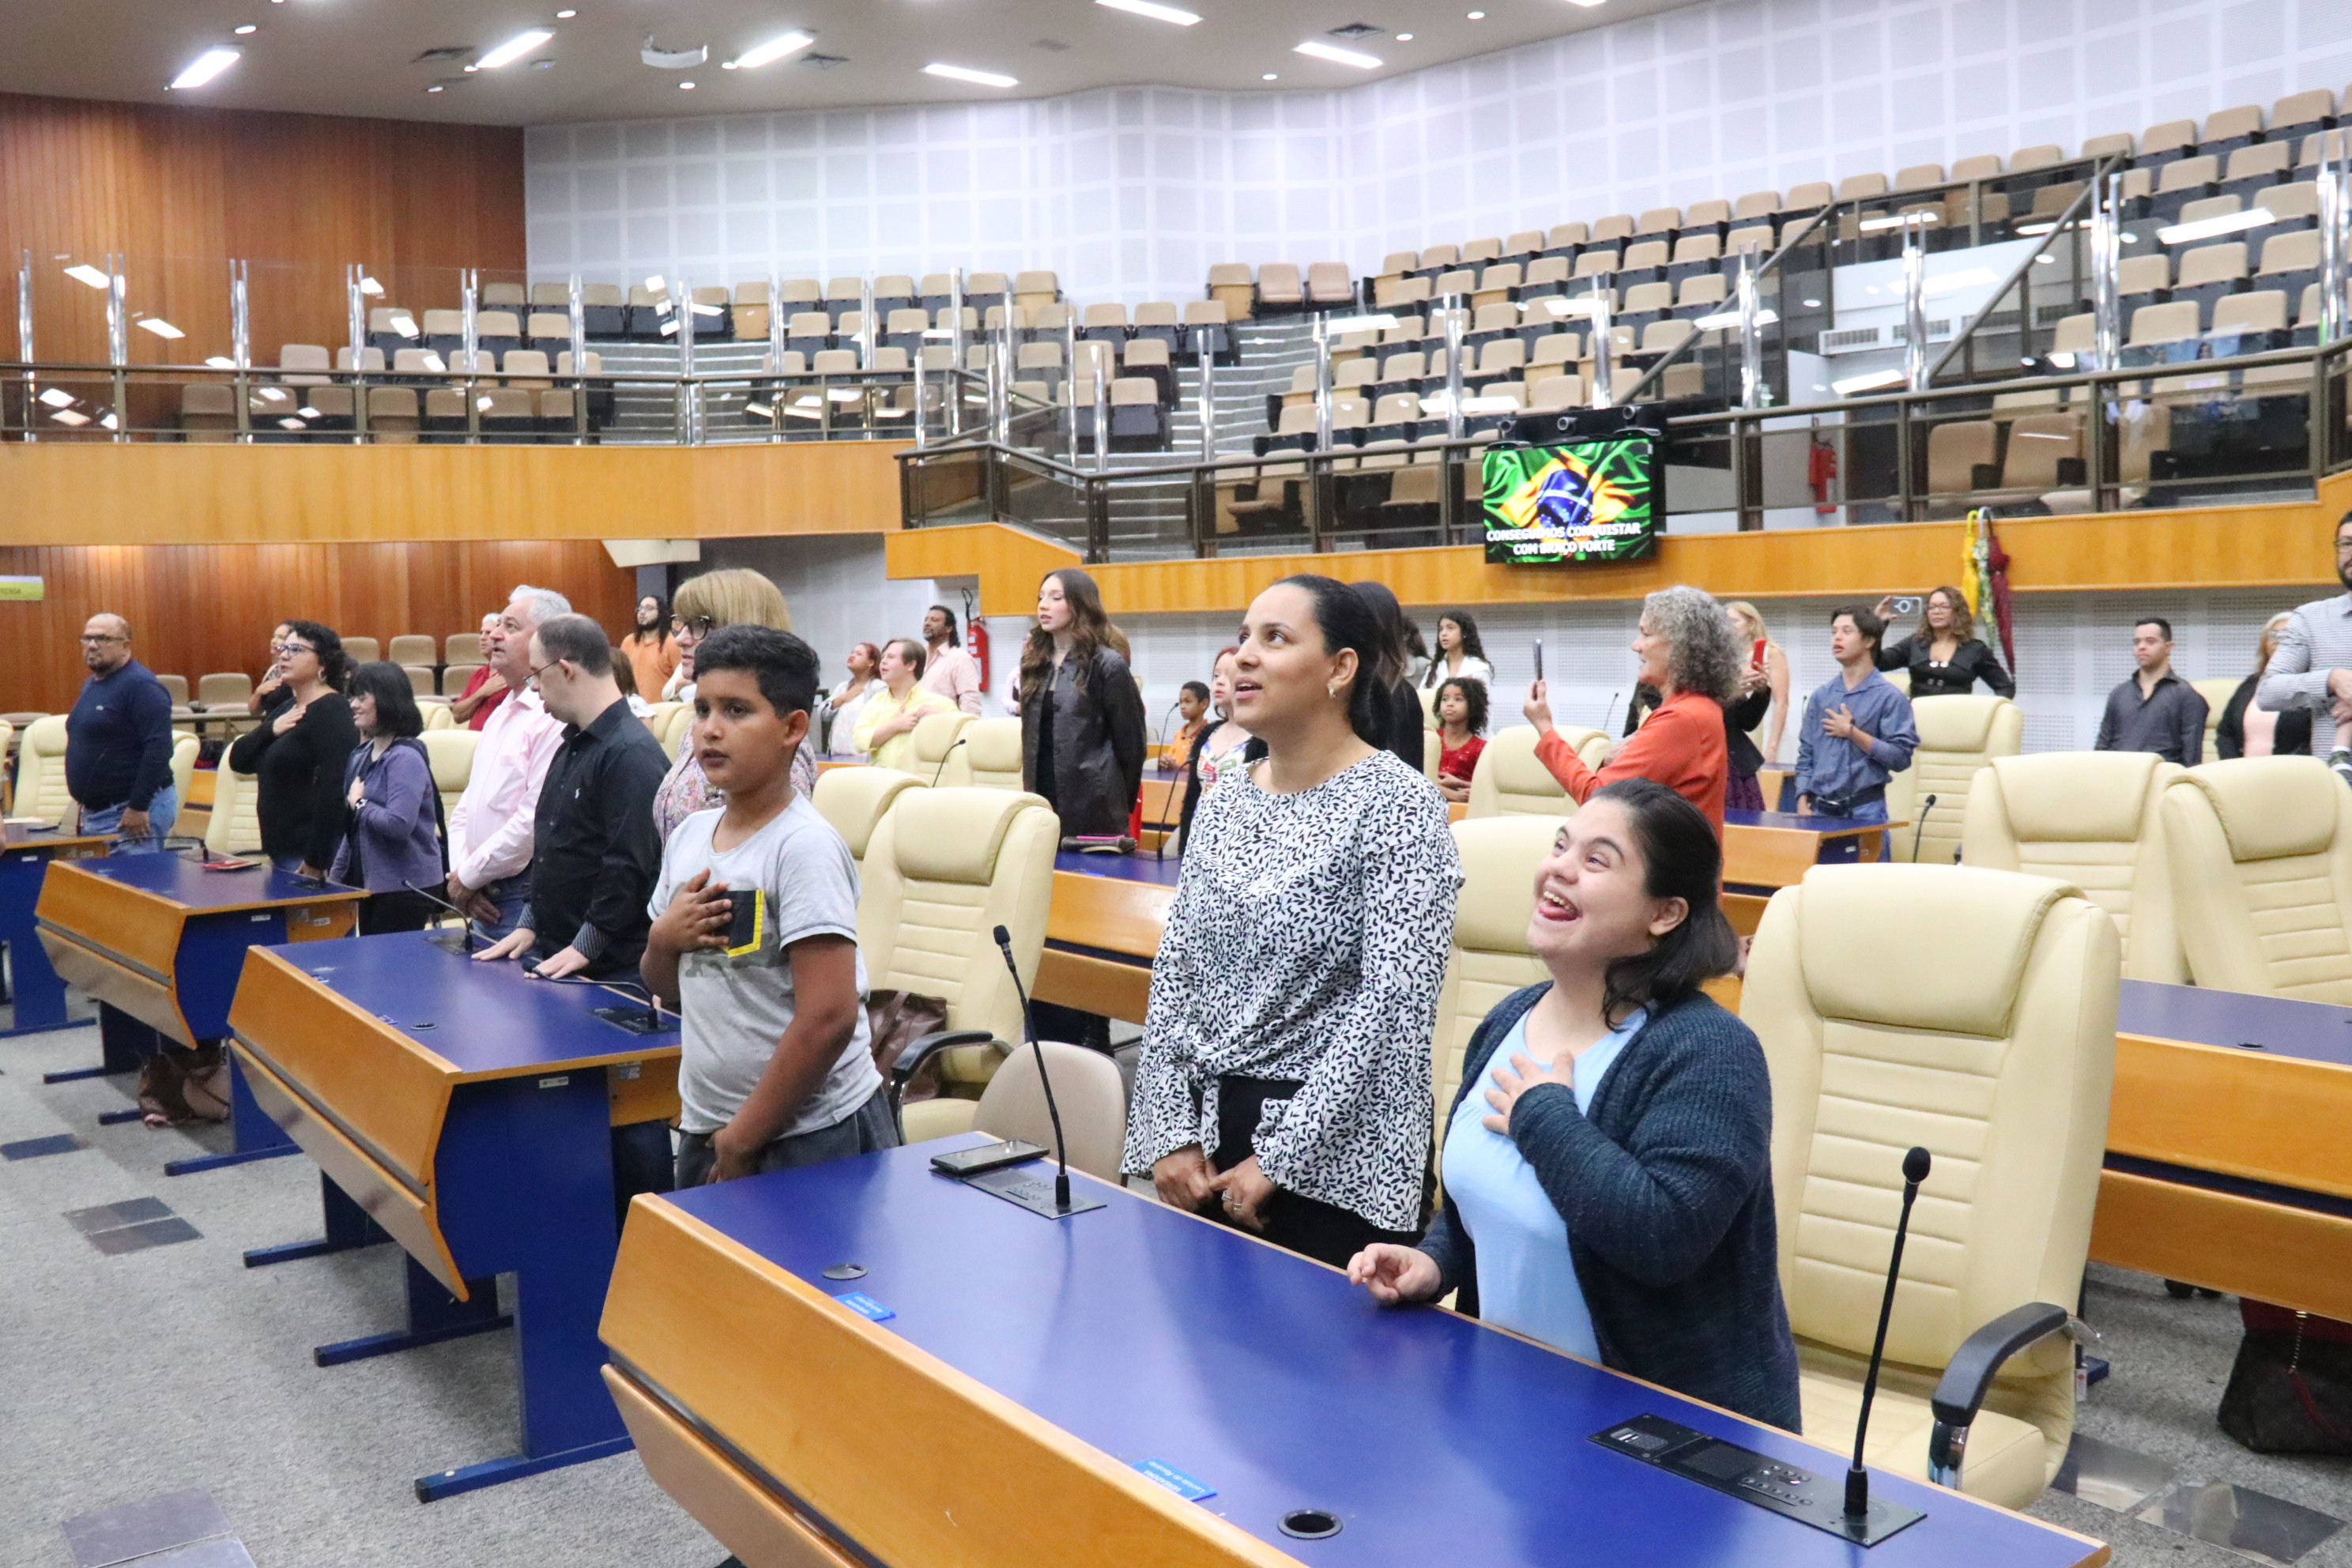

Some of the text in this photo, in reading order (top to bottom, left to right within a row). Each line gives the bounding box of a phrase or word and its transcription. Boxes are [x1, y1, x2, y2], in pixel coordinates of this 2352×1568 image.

[1487, 522, 1642, 542] CONSEGUIMOS CONQUISTAR
[1513, 539, 1615, 556] COM BRAÇO FORTE
